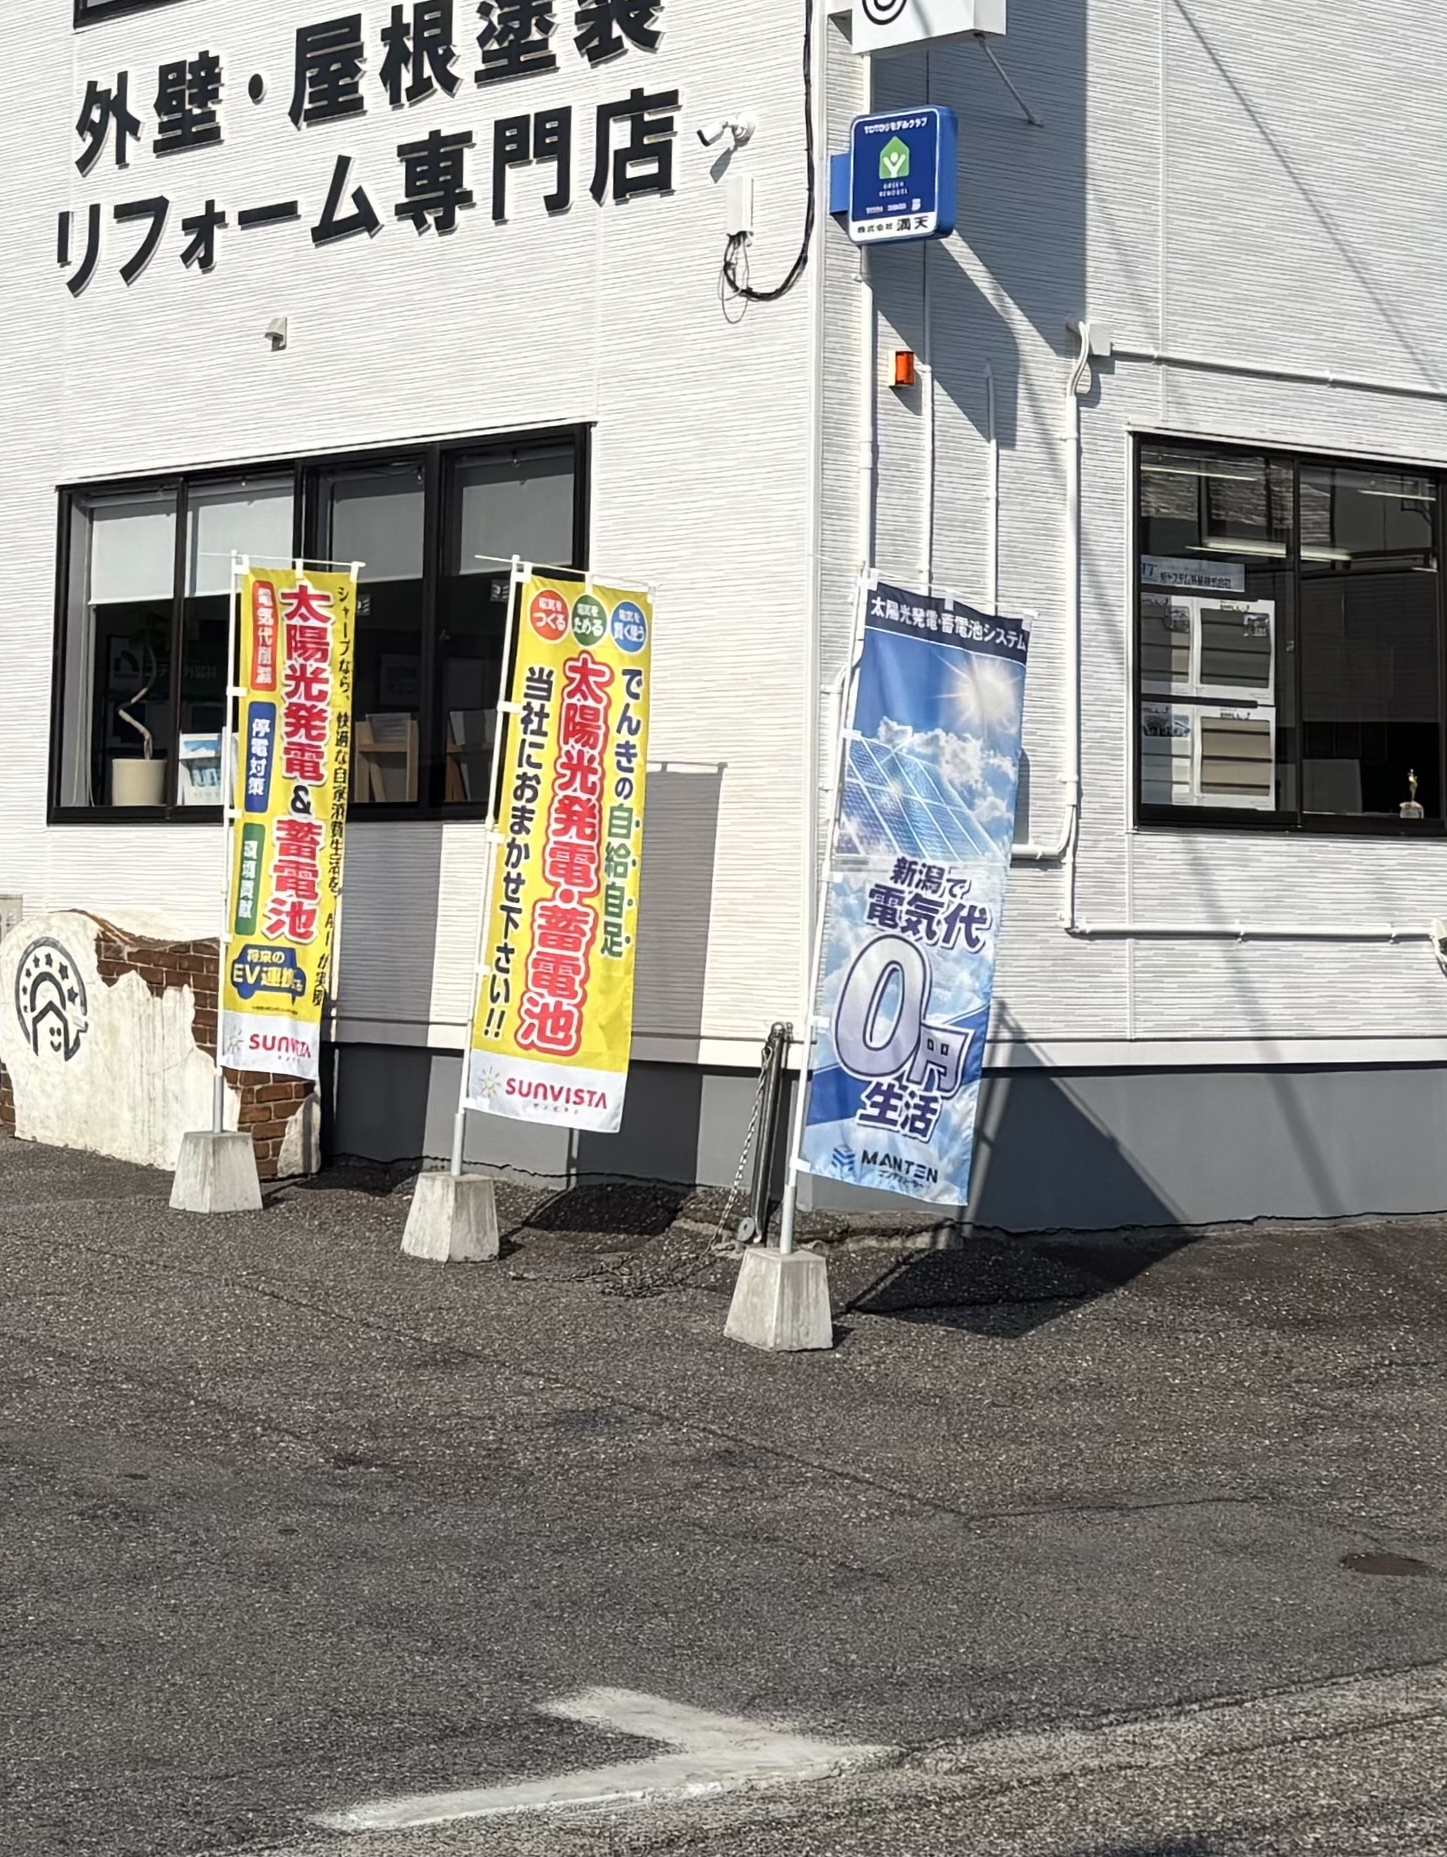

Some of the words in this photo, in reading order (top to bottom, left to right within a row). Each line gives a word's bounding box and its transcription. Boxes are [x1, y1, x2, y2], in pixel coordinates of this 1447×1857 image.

[57, 87, 683, 298] リフォーム専門店
[533, 612, 566, 631] つくる
[601, 669, 644, 959] でんきの自給自足
[889, 856, 969, 899] 新潟で
[867, 883, 989, 950] 電気代
[505, 1077, 608, 1110] SUNVISTA
[857, 1082, 942, 1141] 生活
[861, 1149, 939, 1184] MANTEN
